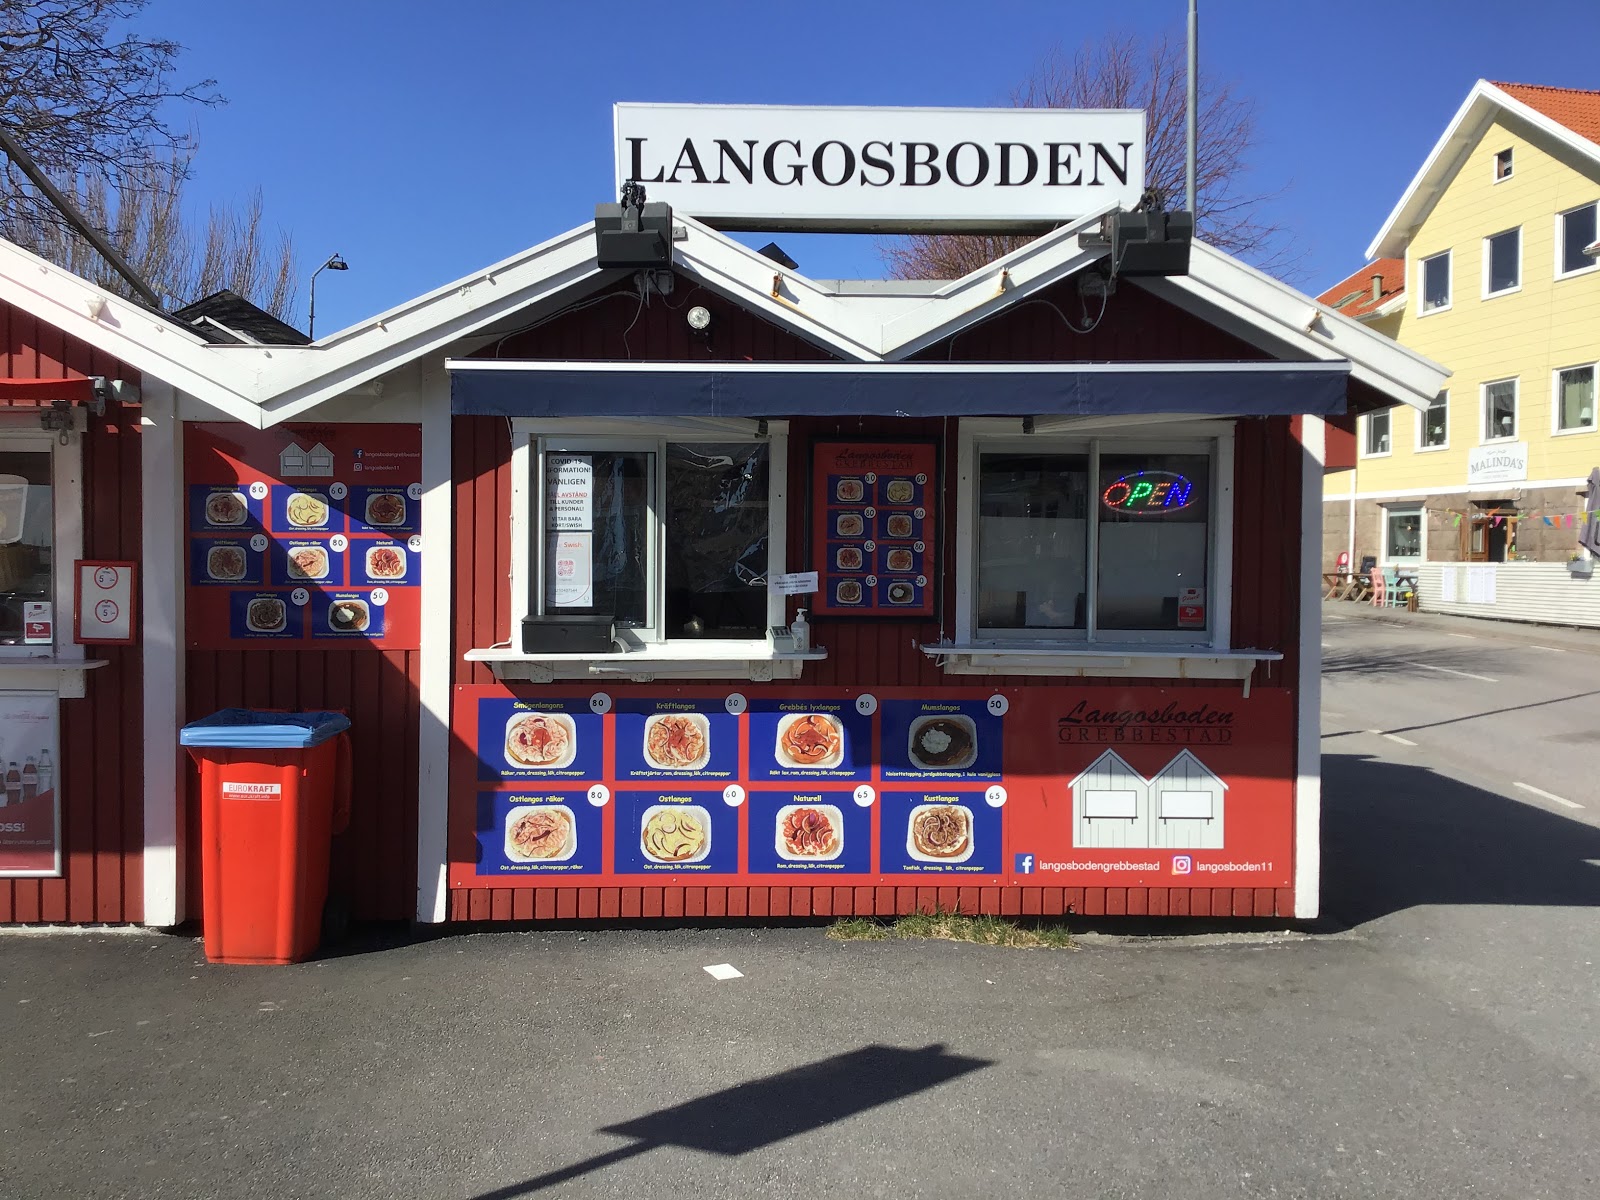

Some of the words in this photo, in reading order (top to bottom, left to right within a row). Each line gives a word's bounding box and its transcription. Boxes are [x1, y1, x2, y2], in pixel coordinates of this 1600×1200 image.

[625, 136, 1134, 187] LANGOSBODEN
[1471, 456, 1524, 474] MALINDA'S
[916, 474, 926, 482] 60
[330, 487, 343, 495] 60
[411, 487, 422, 495] 80
[1102, 482, 1193, 507] OPEN
[865, 508, 875, 517] 80
[252, 539, 265, 547] 80
[332, 539, 343, 547] 80
[409, 538, 421, 547] 65
[865, 542, 875, 550] 65
[866, 576, 876, 584] 65
[293, 591, 305, 600] 65
[372, 591, 384, 600] 50
[103, 609, 108, 617] 5
[592, 699, 604, 707] 80
[656, 702, 696, 711] Kräftlangos
[727, 699, 739, 707] 80
[779, 702, 808, 711] Grebbés
[810, 702, 841, 712] lyxlangos
[859, 701, 870, 709] 80
[921, 703, 961, 712] Mumslangos
[990, 700, 1002, 709] 50
[1058, 700, 1234, 729] Langosboden
[1058, 727, 1232, 743] GREBBESTAD
[229, 784, 274, 793] EUROKRAFT
[590, 791, 602, 799] 80
[725, 790, 736, 798] 60
[793, 794, 822, 802] Naturell
[857, 790, 868, 799] 65
[923, 794, 959, 803] Kustlangos
[989, 792, 1000, 800] 65
[509, 795, 543, 804] Ostlangos
[545, 795, 565, 803] räkor
[658, 795, 692, 804] Ostlangos
[1039, 860, 1160, 873] langosbodengrebbestad
[1196, 860, 1273, 873] langosboden11
